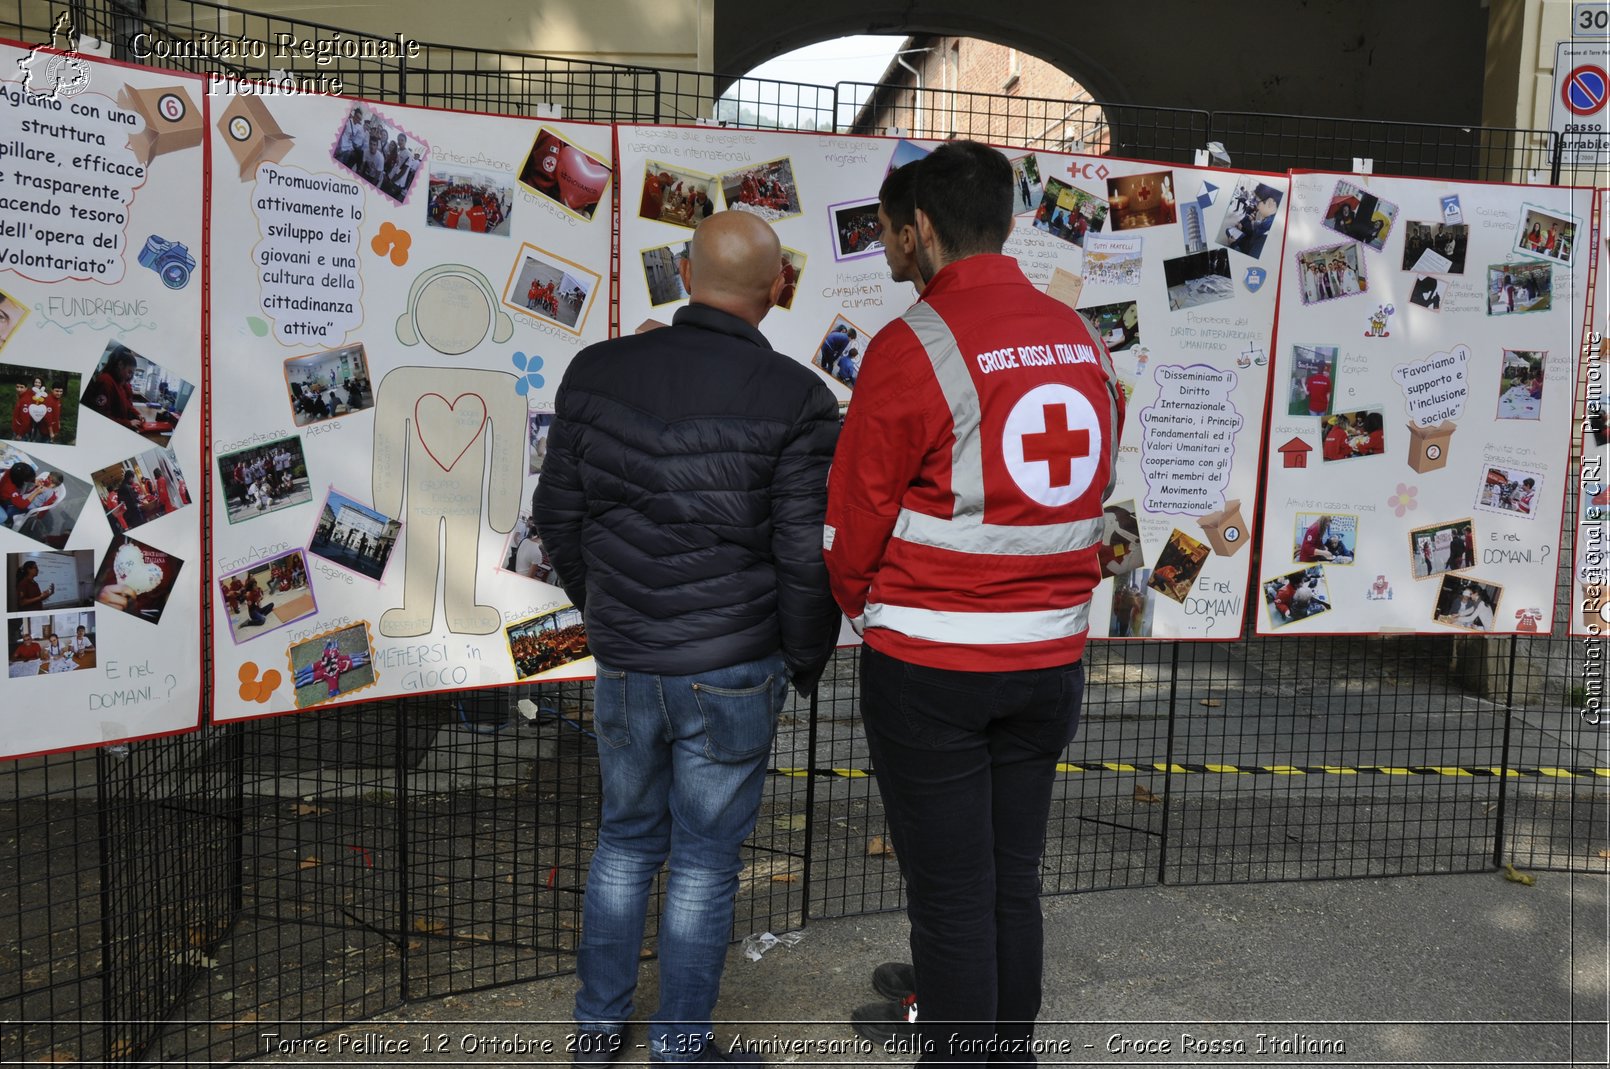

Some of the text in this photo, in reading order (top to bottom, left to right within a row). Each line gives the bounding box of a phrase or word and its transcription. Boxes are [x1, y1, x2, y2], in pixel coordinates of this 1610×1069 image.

[1580, 10, 1608, 29] 30
[70, 103, 100, 119] con
[107, 110, 136, 126] una
[166, 99, 179, 117] 6
[21, 119, 105, 146] struttura
[233, 121, 248, 137] 5
[1565, 124, 1601, 133] passo
[674, 147, 681, 157] e
[1557, 139, 1609, 149] arrabile
[72, 155, 144, 178] efficace
[14, 170, 126, 203] trasparente,
[70, 204, 125, 225] tesoro
[257, 196, 362, 221] attivamente lo
[93, 232, 118, 249] del
[267, 223, 351, 244] sviluppo dei
[260, 249, 356, 268] giovani e una
[262, 269, 355, 290] cultura della
[822, 284, 882, 298] CAMBIAMENTI
[263, 295, 354, 314] cittadinanza
[841, 297, 883, 309] CLIMATICI
[283, 322, 334, 337] attiva”
[977, 343, 1099, 374] CROCE ROSSA ITALIANA
[1459, 350, 1466, 362] il
[1227, 374, 1232, 383] il
[1407, 371, 1463, 396] supporto e
[1179, 386, 1210, 396] Diritto
[1348, 386, 1357, 397] e
[1409, 387, 1467, 411] l'inclusione
[1160, 400, 1226, 411] Internazionale
[1144, 414, 1240, 427] Umanitario, i Principi
[1421, 403, 1461, 426] sociale”
[305, 419, 342, 439] Azione
[1150, 428, 1231, 440] Fondamentali ed i
[1147, 441, 1173, 451] Valori
[1176, 442, 1220, 453] Umanitari
[1224, 445, 1230, 453] e
[1430, 447, 1438, 458] 2
[1145, 456, 1228, 470] cooperiamo con gli
[1148, 470, 1222, 482] altri membri del
[1160, 485, 1207, 495] Movimento
[1226, 528, 1236, 539] 4
[1490, 532, 1521, 542] E nel
[314, 559, 354, 585] Legame
[1199, 577, 1232, 594] E nel
[1184, 597, 1242, 616] DOMANI
[465, 644, 482, 661] in
[106, 660, 154, 680] E nel
